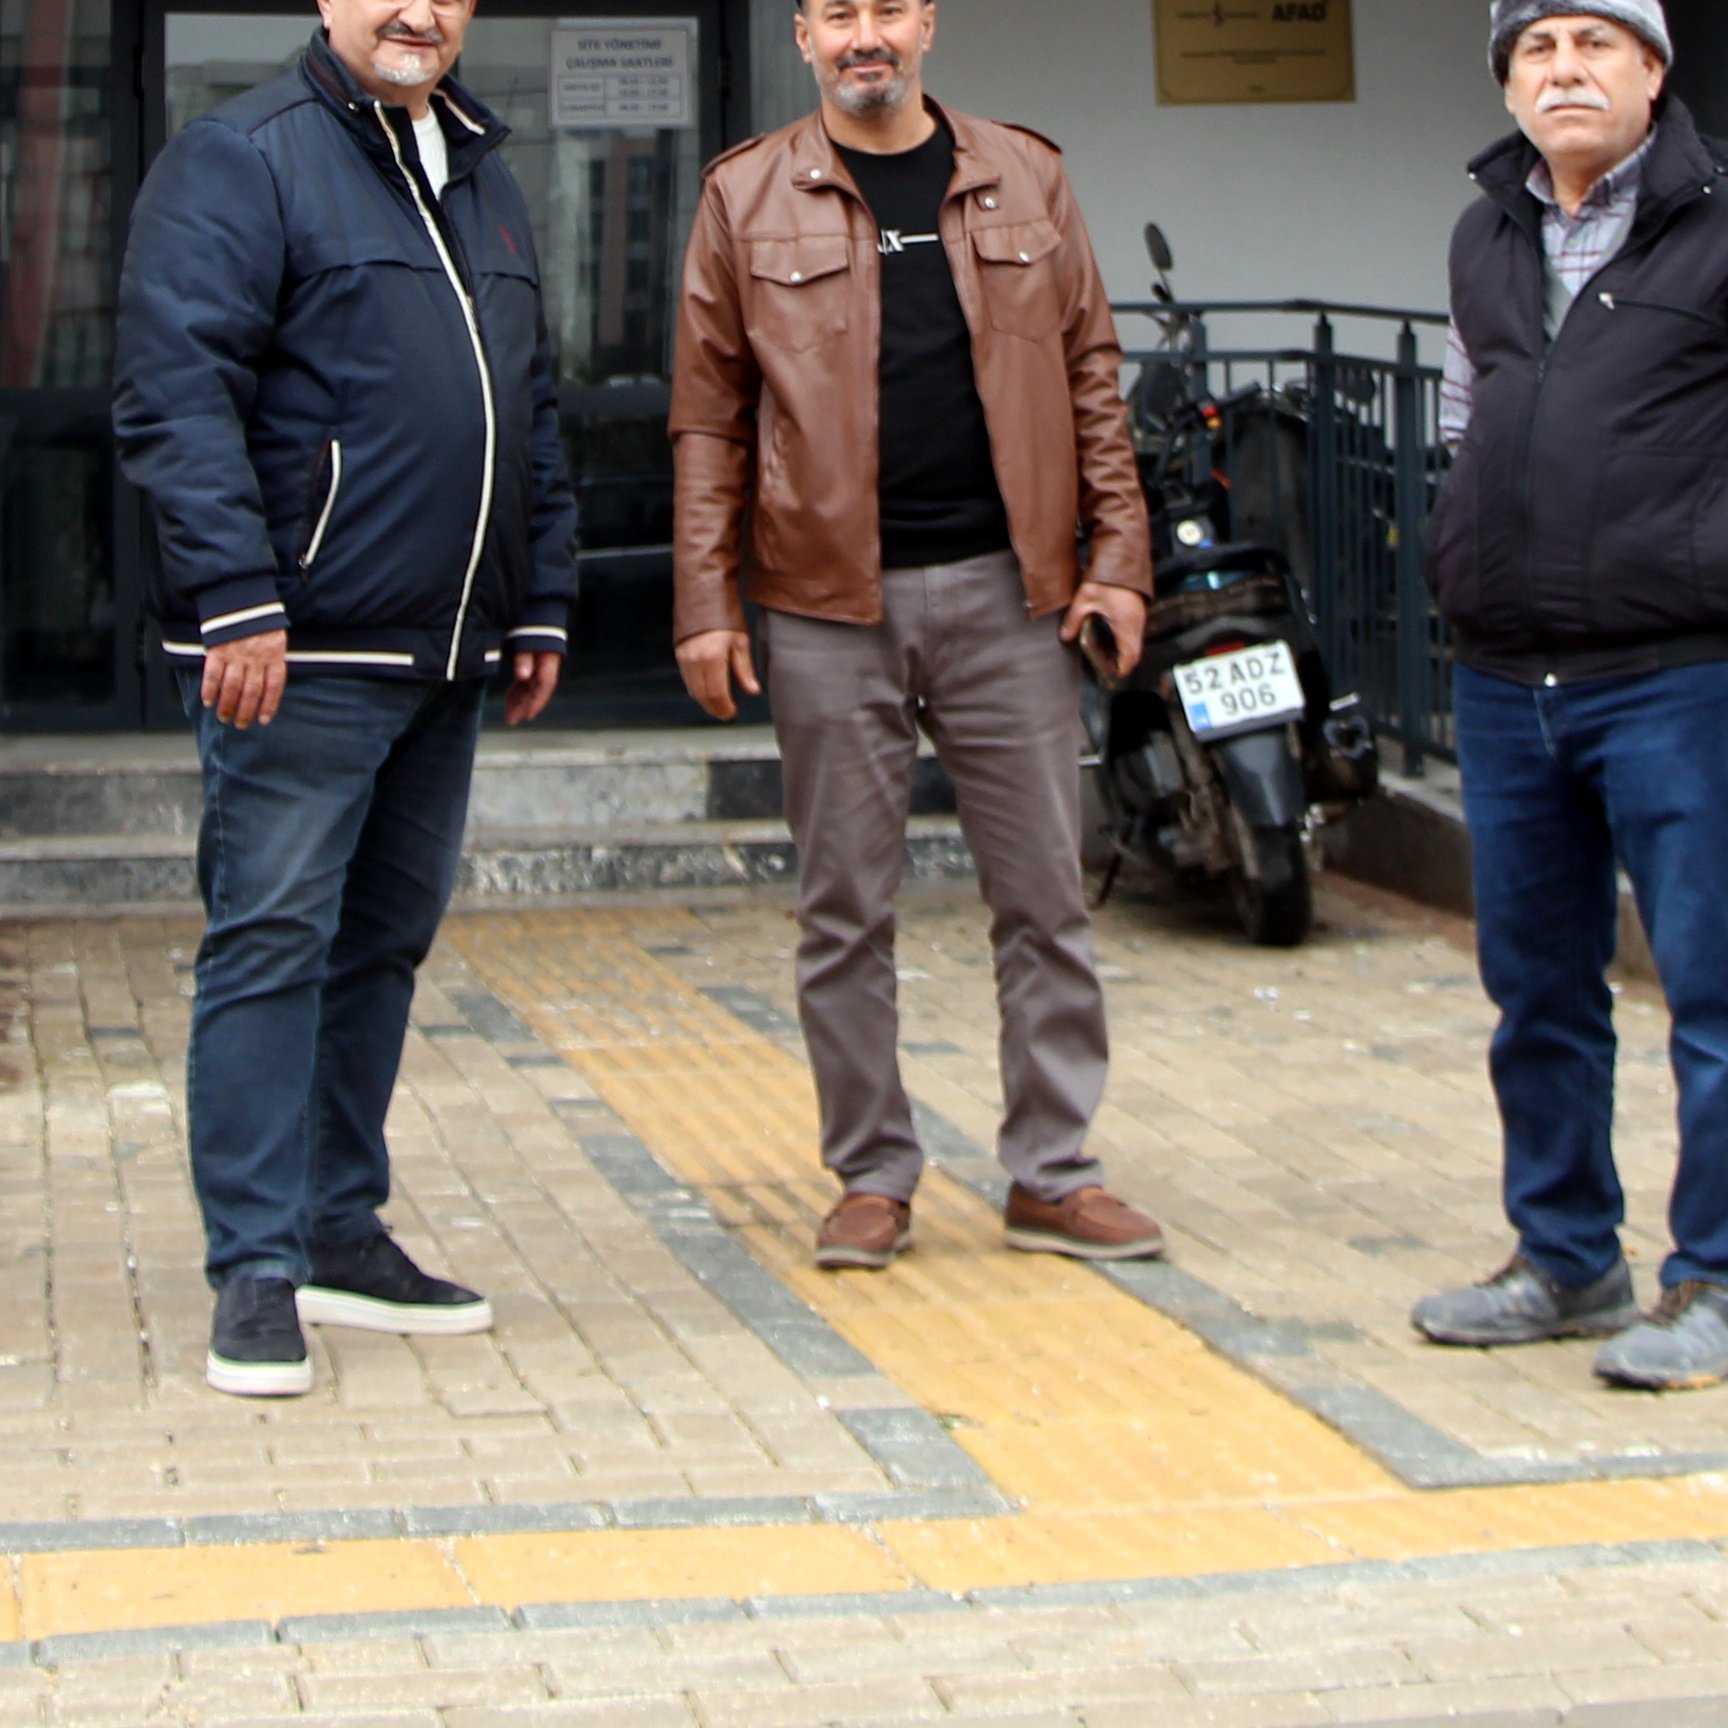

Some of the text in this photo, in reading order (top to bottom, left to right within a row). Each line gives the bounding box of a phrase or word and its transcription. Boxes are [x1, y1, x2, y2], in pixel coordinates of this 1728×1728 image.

[1183, 652, 1285, 696] 52 ADZ
[1220, 682, 1277, 716] 906
